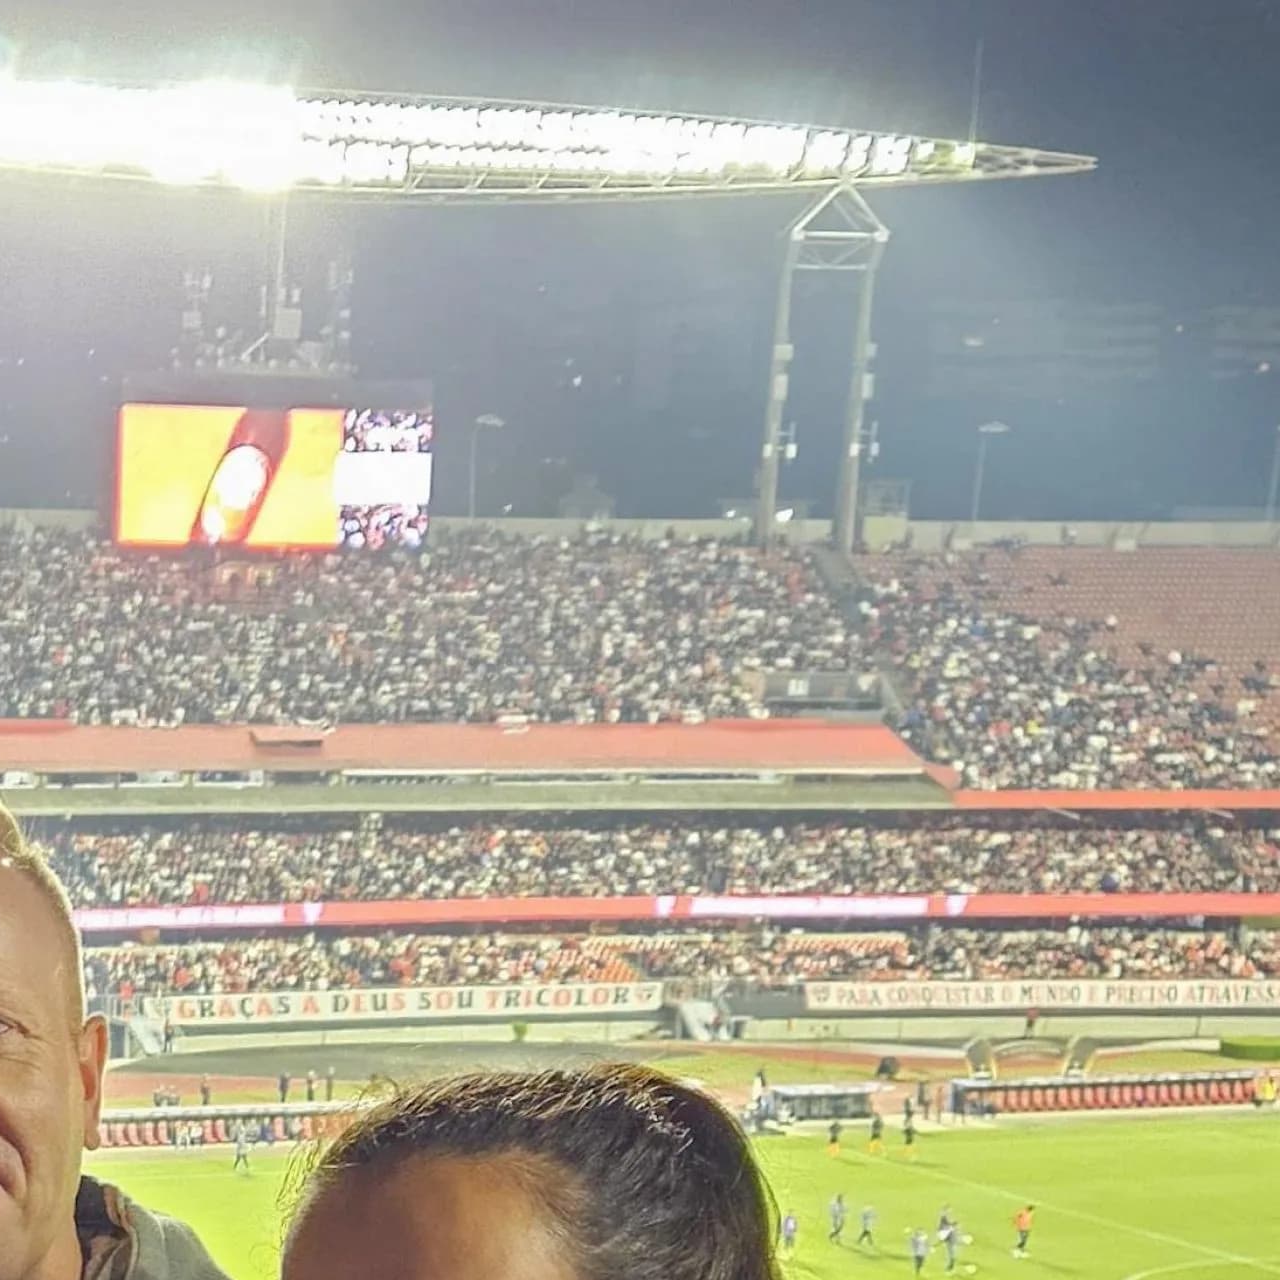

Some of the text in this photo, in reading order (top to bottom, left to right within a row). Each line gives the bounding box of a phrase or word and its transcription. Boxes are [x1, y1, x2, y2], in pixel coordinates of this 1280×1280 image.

[177, 985, 629, 1019] GRAÇAS A DEUS SOU TRICOLOR
